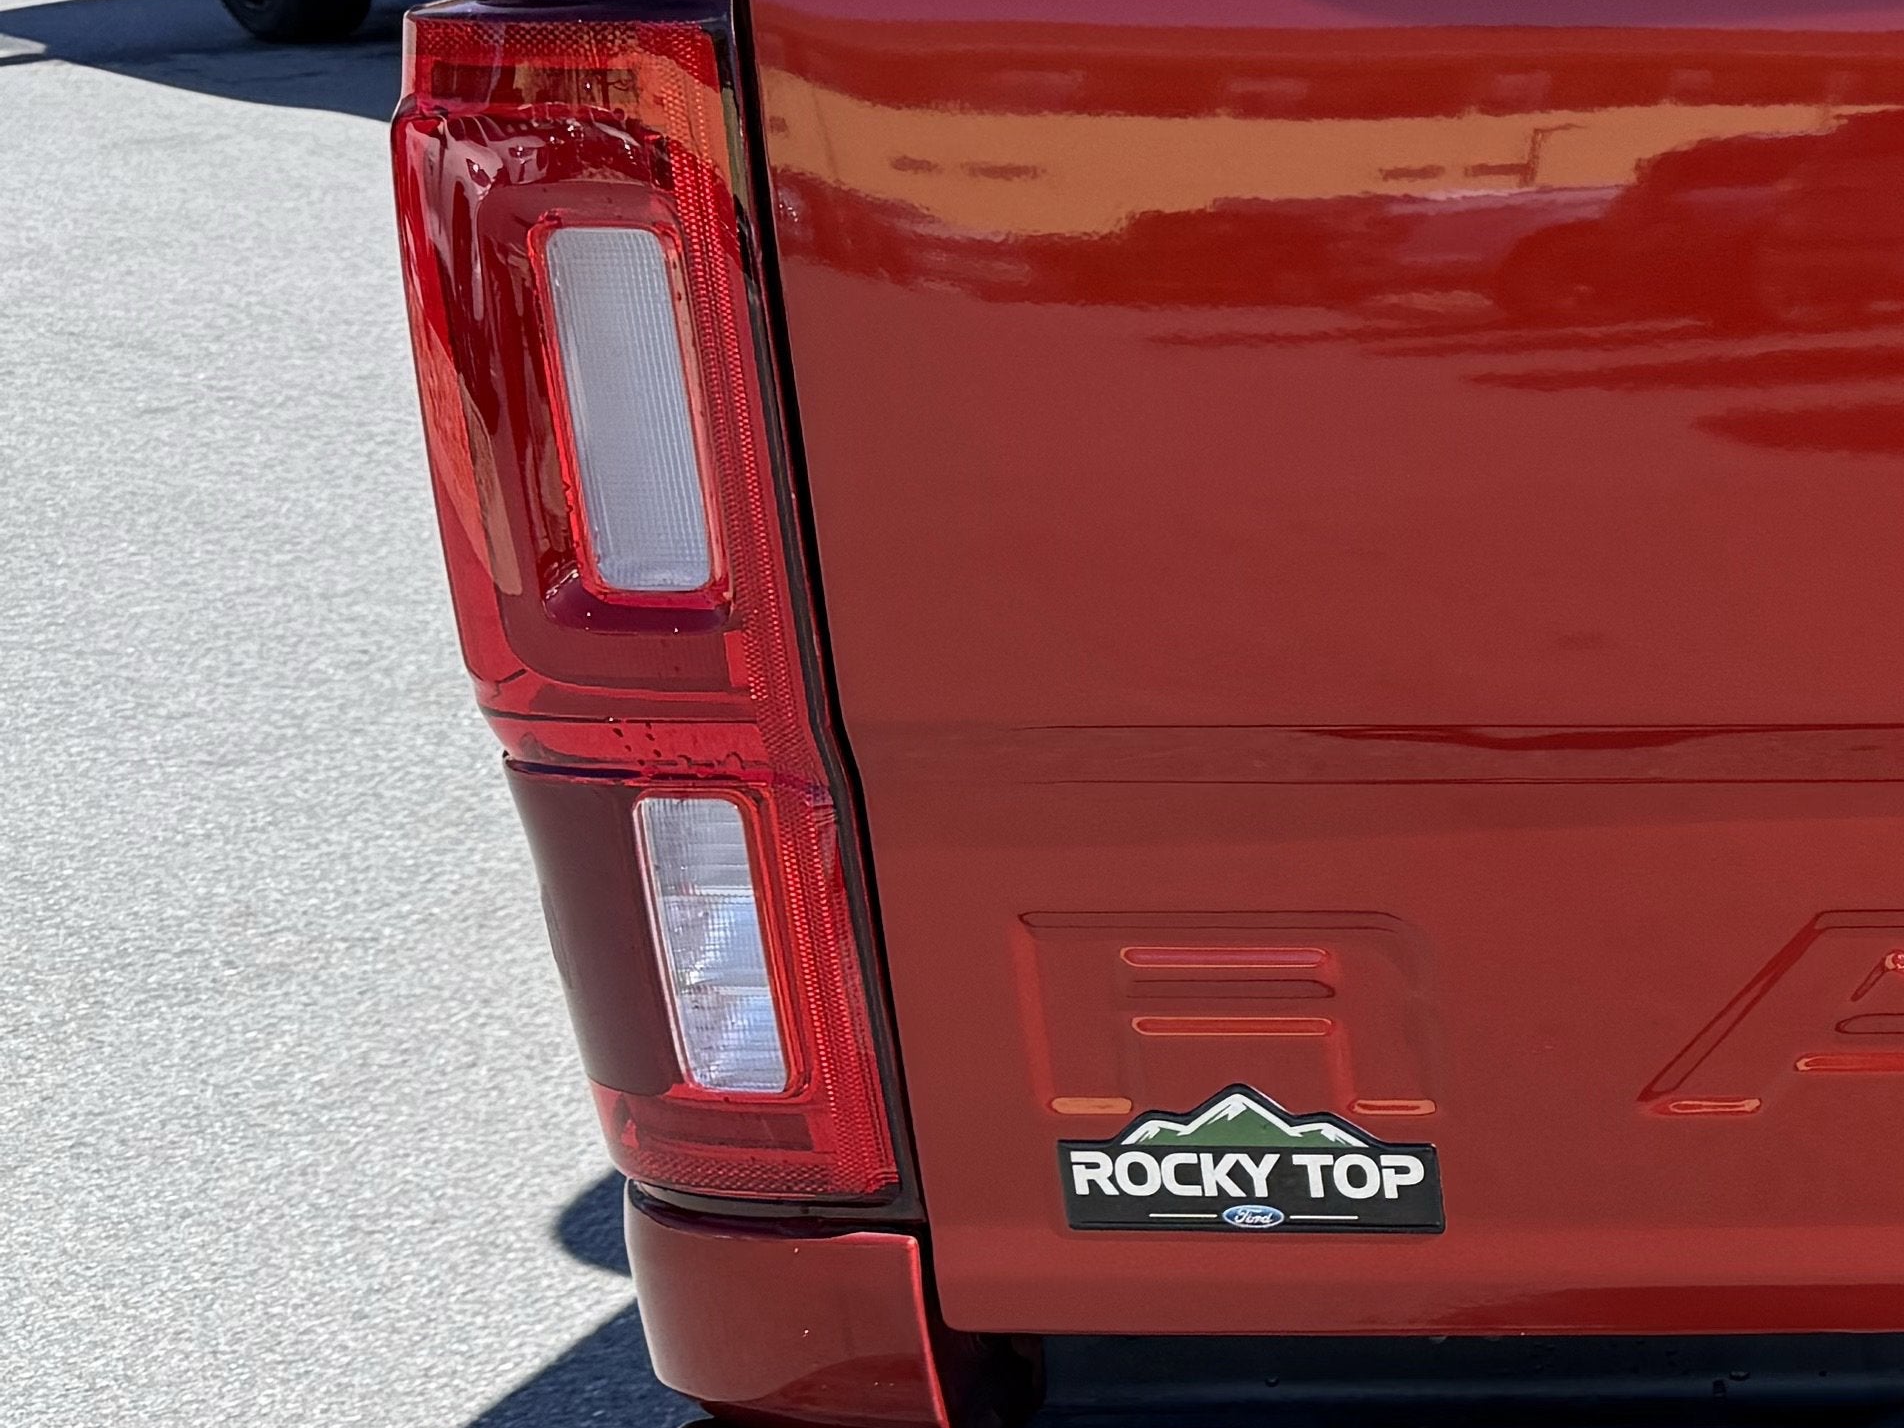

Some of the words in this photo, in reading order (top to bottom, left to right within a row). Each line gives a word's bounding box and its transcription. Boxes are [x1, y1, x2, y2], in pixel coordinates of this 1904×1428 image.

[1070, 1151, 1281, 1198] ROCKY
[1292, 1154, 1425, 1200] TOP
[1234, 1207, 1274, 1224] Ford
